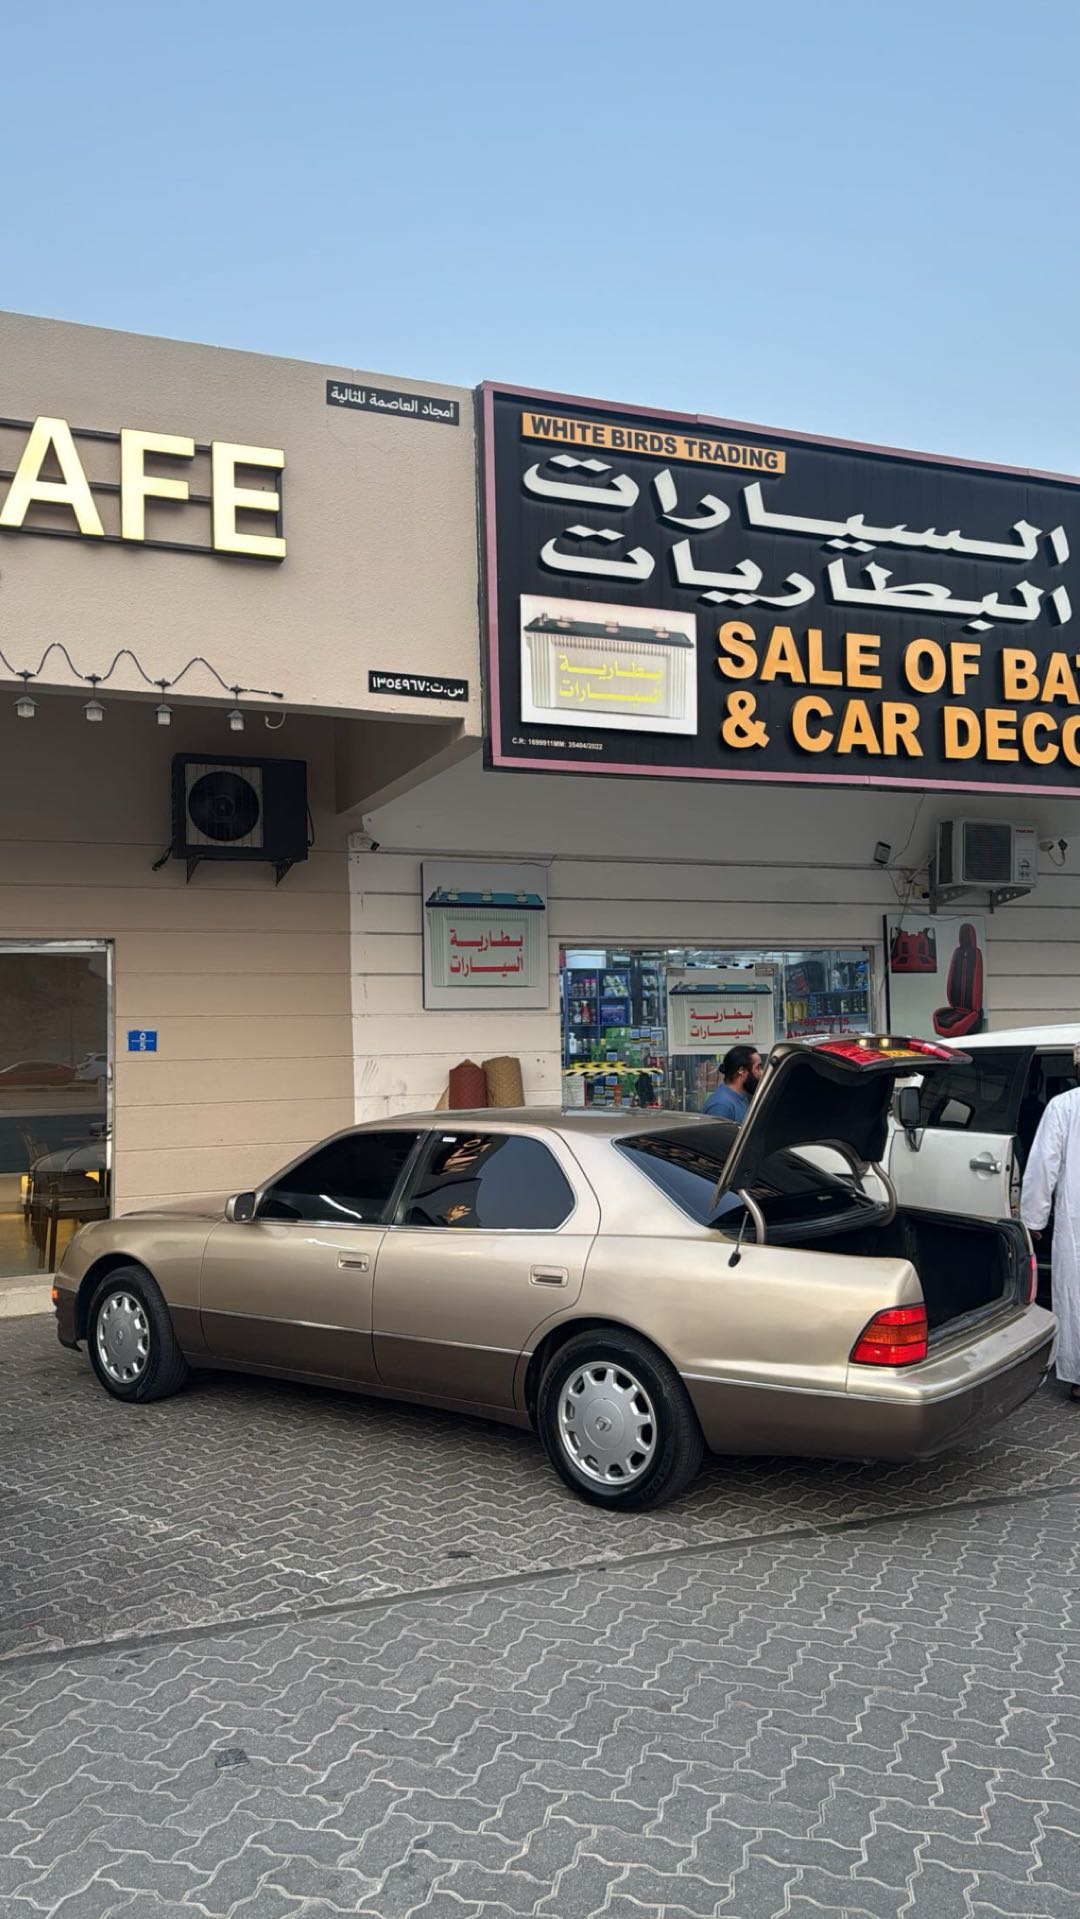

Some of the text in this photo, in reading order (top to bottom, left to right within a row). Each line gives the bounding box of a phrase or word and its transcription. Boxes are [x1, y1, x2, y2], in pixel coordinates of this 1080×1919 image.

[369, 393, 419, 413] العاصمة
[422, 402, 454, 419] أمجاد
[531, 416, 778, 470] WHITE BIRDS TRADING
[522, 453, 1070, 566] السيارات
[540, 524, 1073, 632] البطاريات
[717, 620, 1080, 705] SALE OF BA
[722, 690, 770, 748] &
[792, 695, 924, 757] CAR
[449, 928, 523, 952] بطارية
[449, 955, 524, 978] السيارات
[689, 1007, 753, 1023] بطارية
[690, 1023, 754, 1040] السيارات
